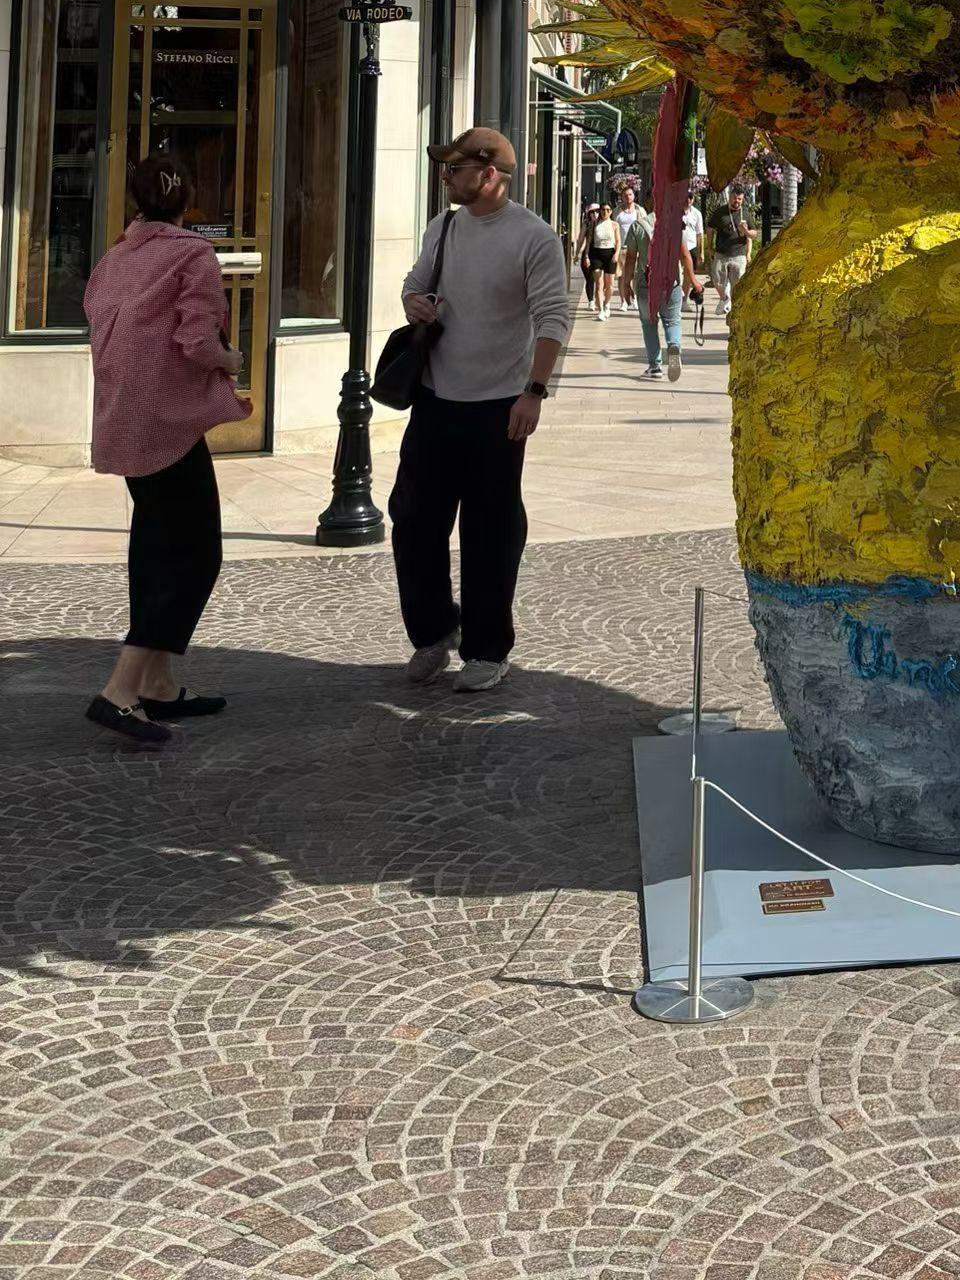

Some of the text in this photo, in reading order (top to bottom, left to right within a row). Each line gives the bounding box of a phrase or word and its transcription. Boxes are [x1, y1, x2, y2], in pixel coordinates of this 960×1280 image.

[346, 7, 404, 20] VIA RODEO
[156, 52, 234, 64] STEFANO RICCI
